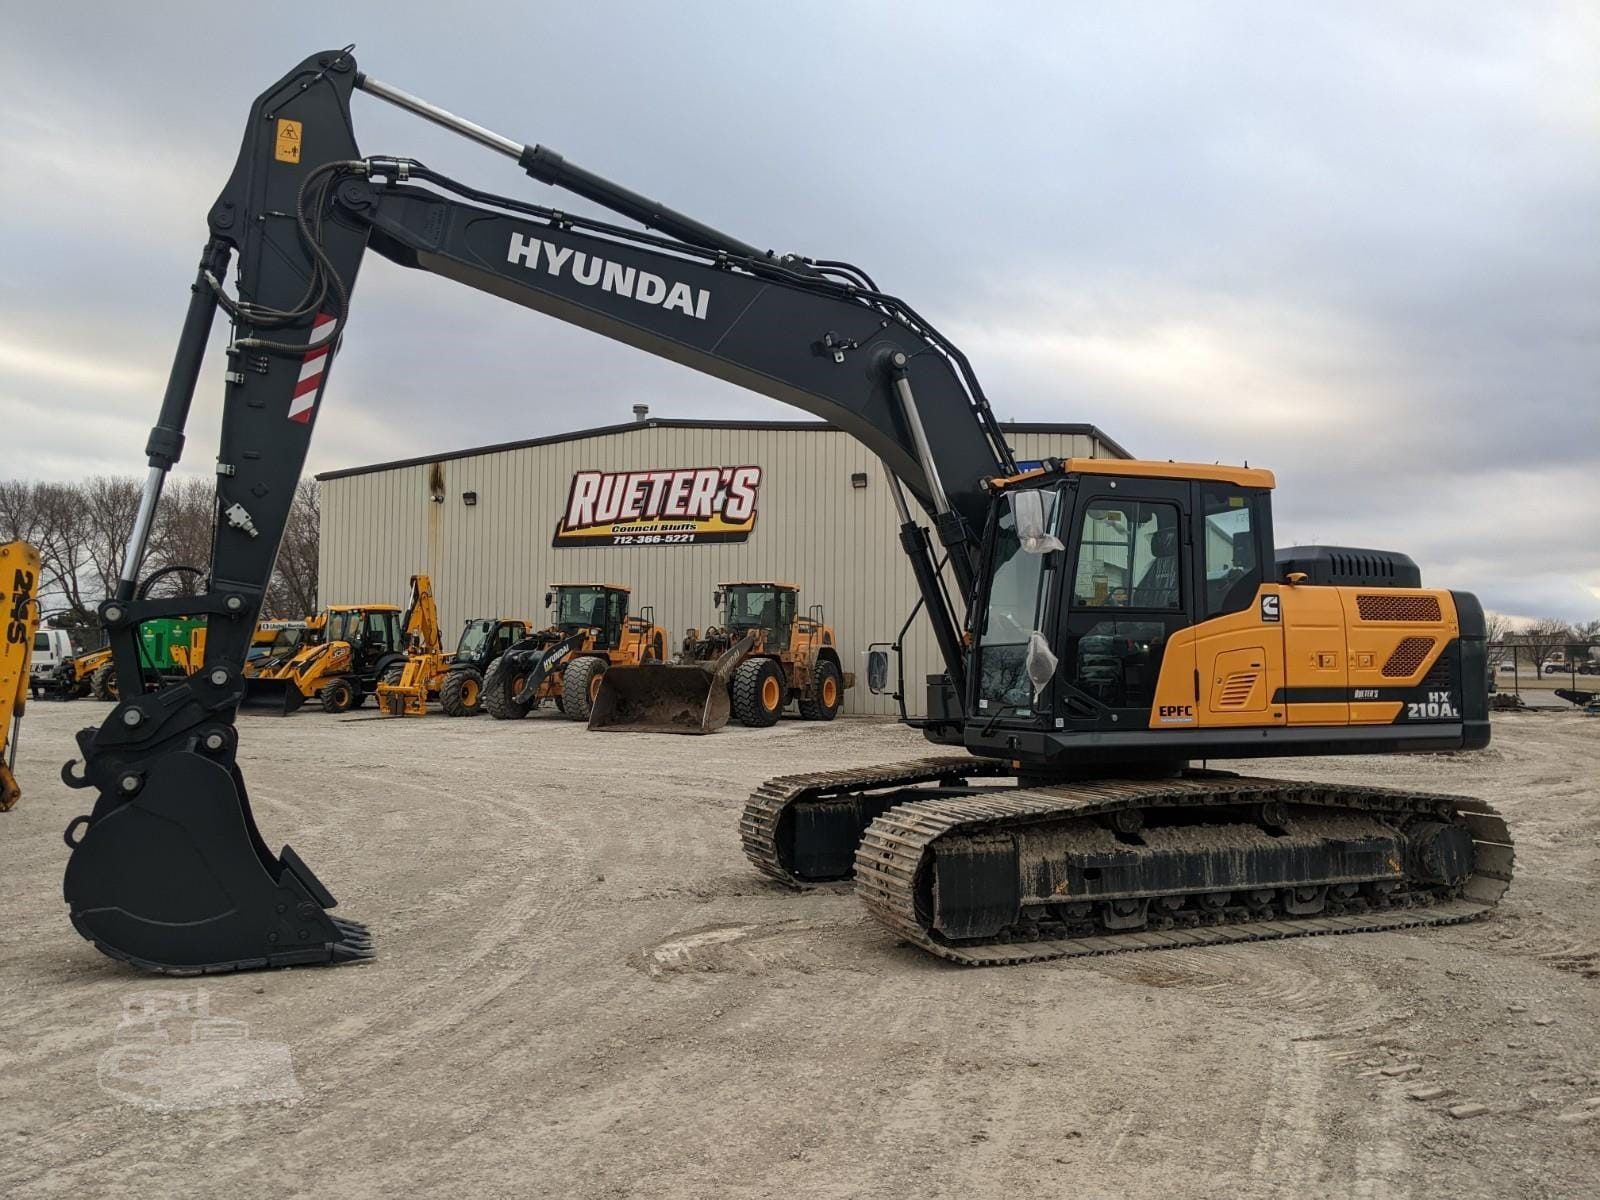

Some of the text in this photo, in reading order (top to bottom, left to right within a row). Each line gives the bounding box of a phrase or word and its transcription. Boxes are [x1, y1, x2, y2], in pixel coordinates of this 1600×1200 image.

[507, 231, 711, 321] HYUNDAI
[566, 466, 761, 529] RUETER'S
[611, 523, 697, 533] Council Bluffs
[613, 533, 695, 545] 712-366-5221
[543, 644, 569, 668] HYUNDAI
[1354, 689, 1379, 698] RUETER'S
[1428, 691, 1449, 702] HX
[1159, 705, 1193, 717] EPFC
[1407, 702, 1460, 718] 210AL
